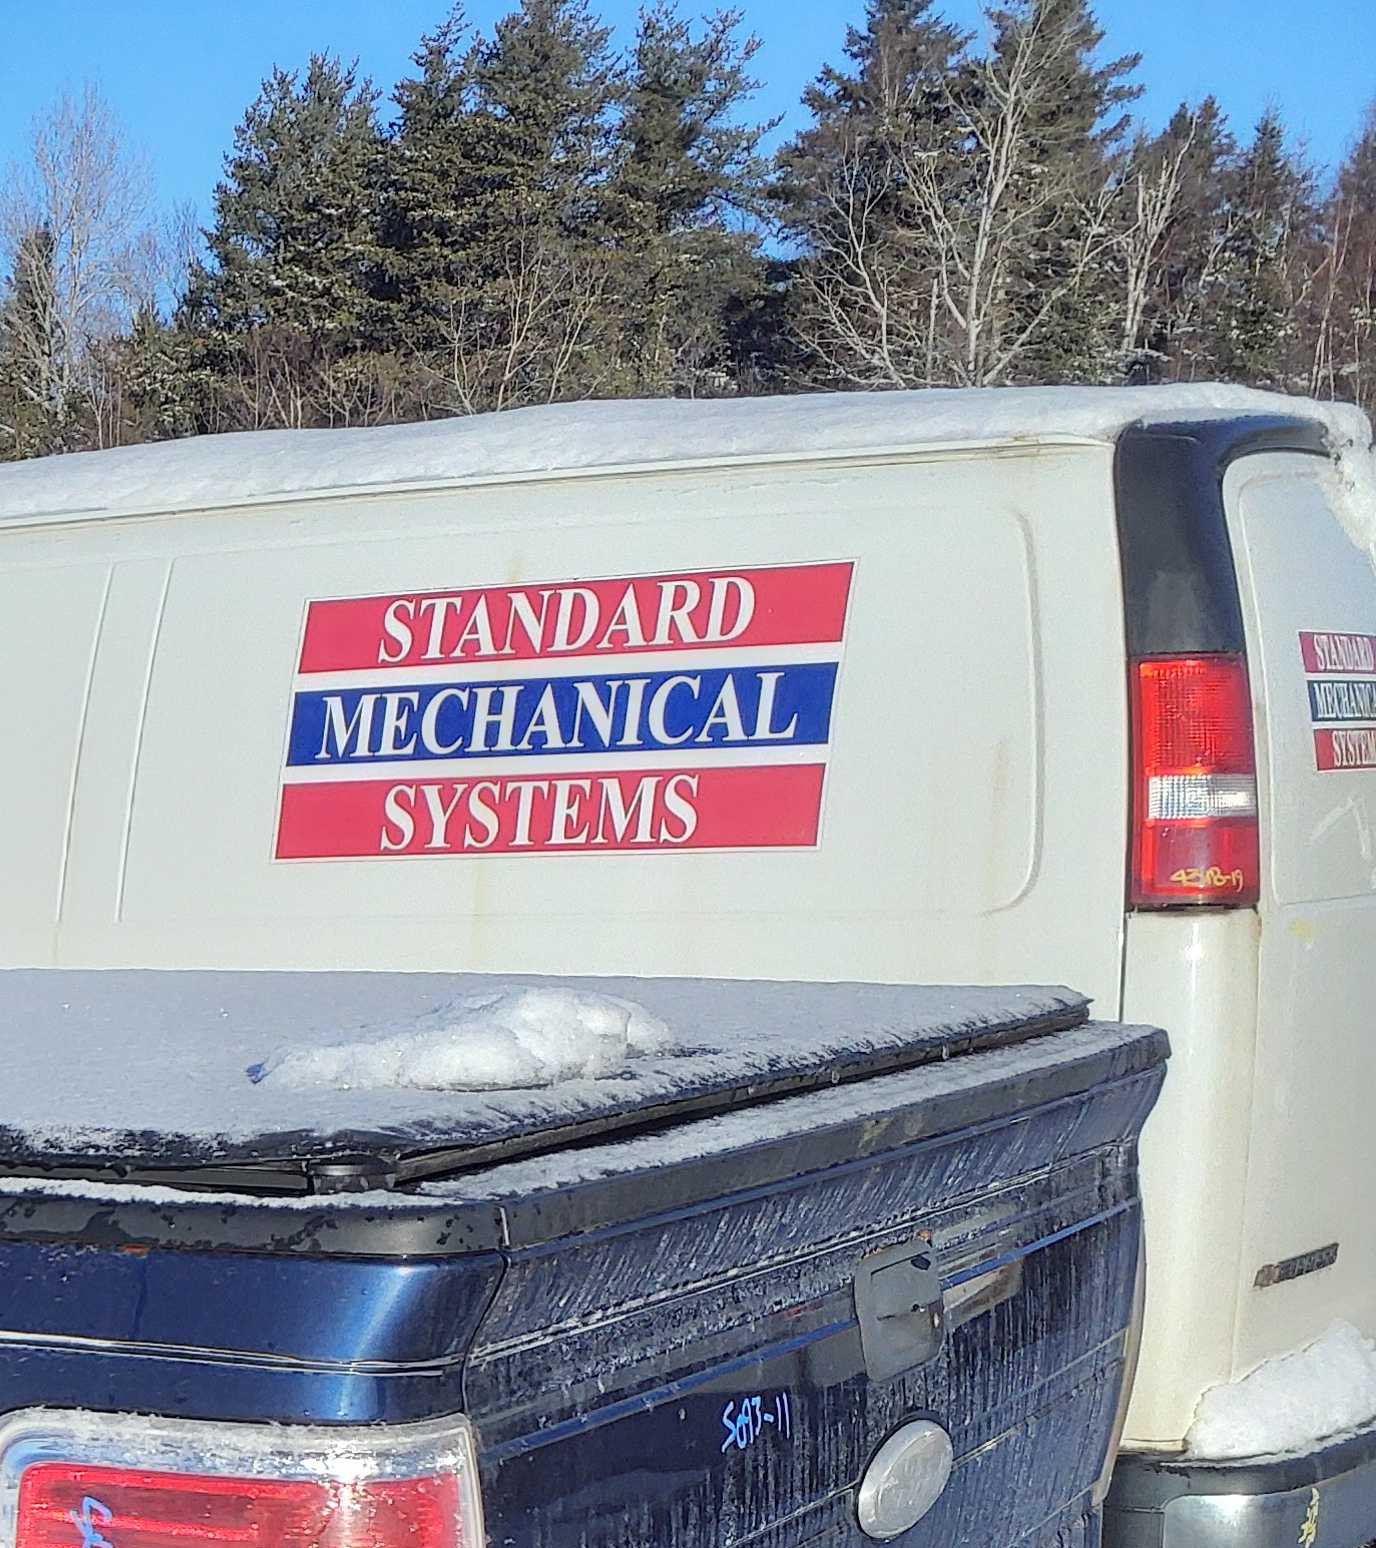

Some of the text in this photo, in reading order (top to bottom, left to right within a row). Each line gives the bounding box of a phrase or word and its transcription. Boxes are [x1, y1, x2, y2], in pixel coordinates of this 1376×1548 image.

[377, 575, 755, 665] STANDARD
[314, 671, 799, 761] MECHANICAL
[379, 773, 701, 854] SYSTEMS
